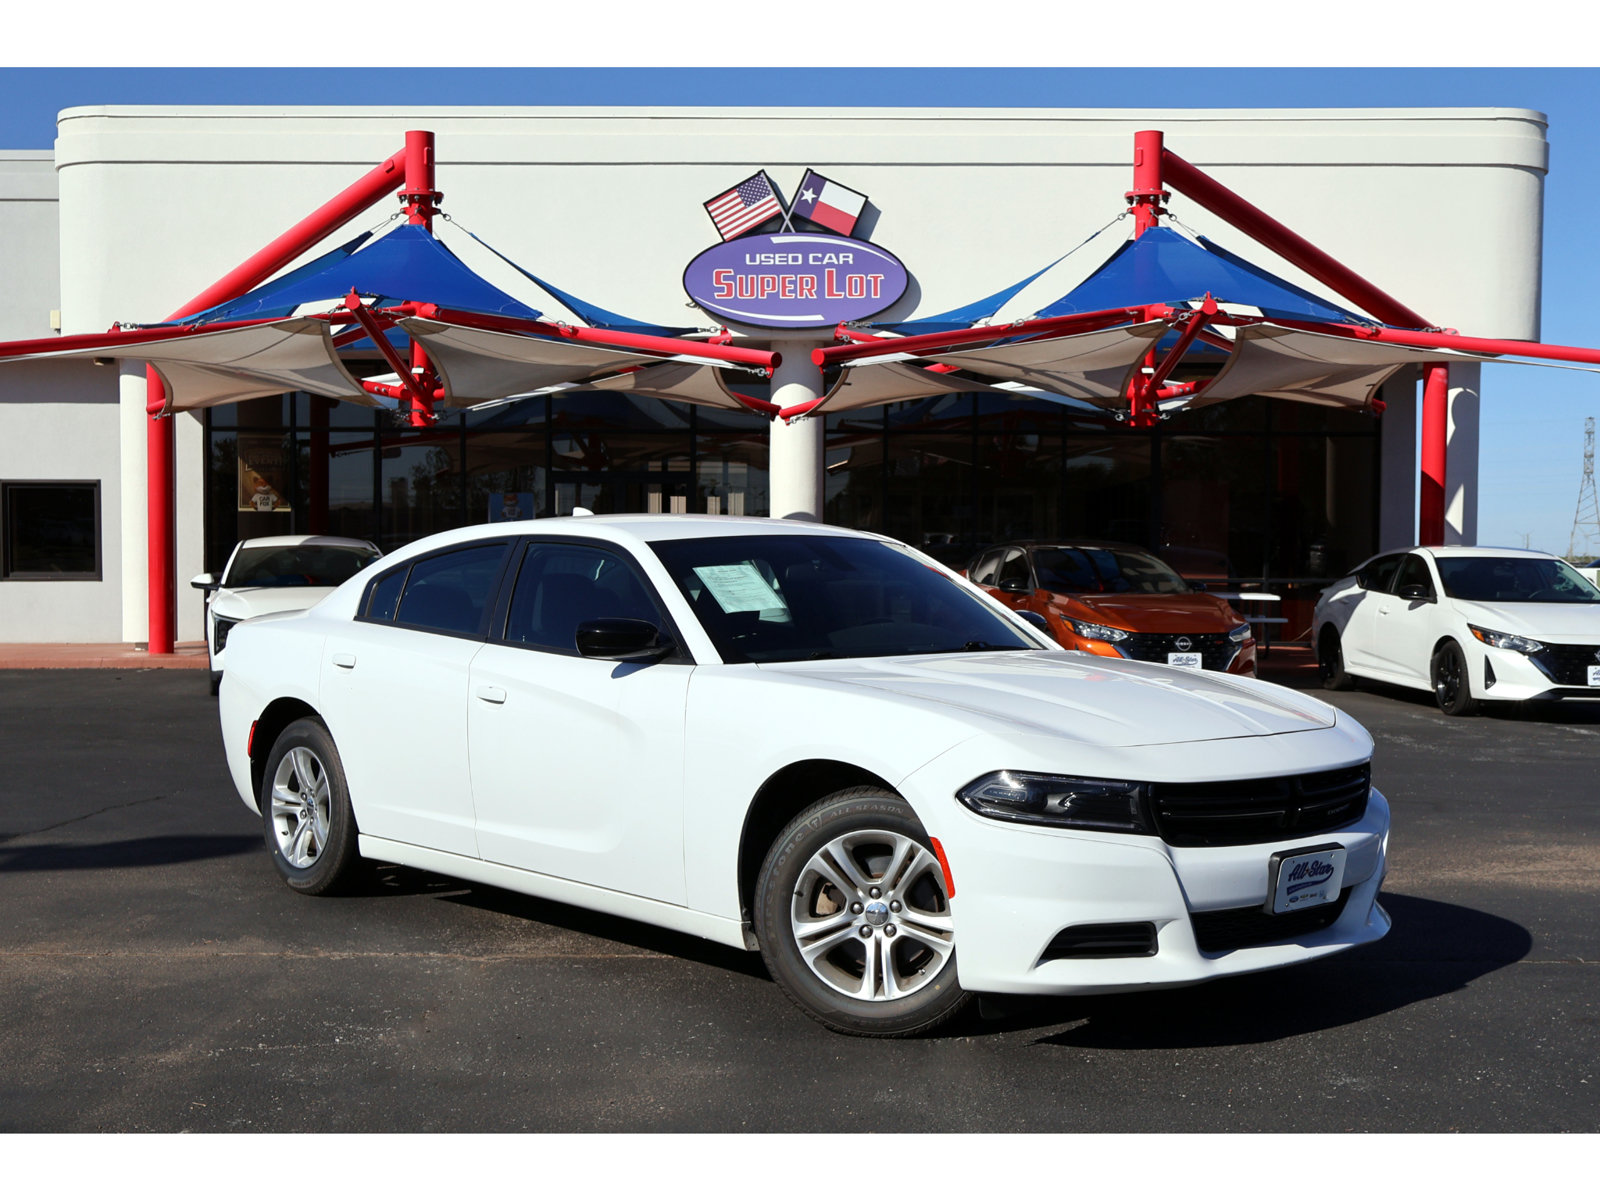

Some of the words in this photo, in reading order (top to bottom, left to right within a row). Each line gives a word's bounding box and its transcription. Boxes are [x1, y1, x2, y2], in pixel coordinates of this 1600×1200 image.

[745, 253, 803, 265] USED
[808, 253, 854, 265] CAR
[713, 268, 817, 299] SUPER
[824, 268, 885, 299] LOT
